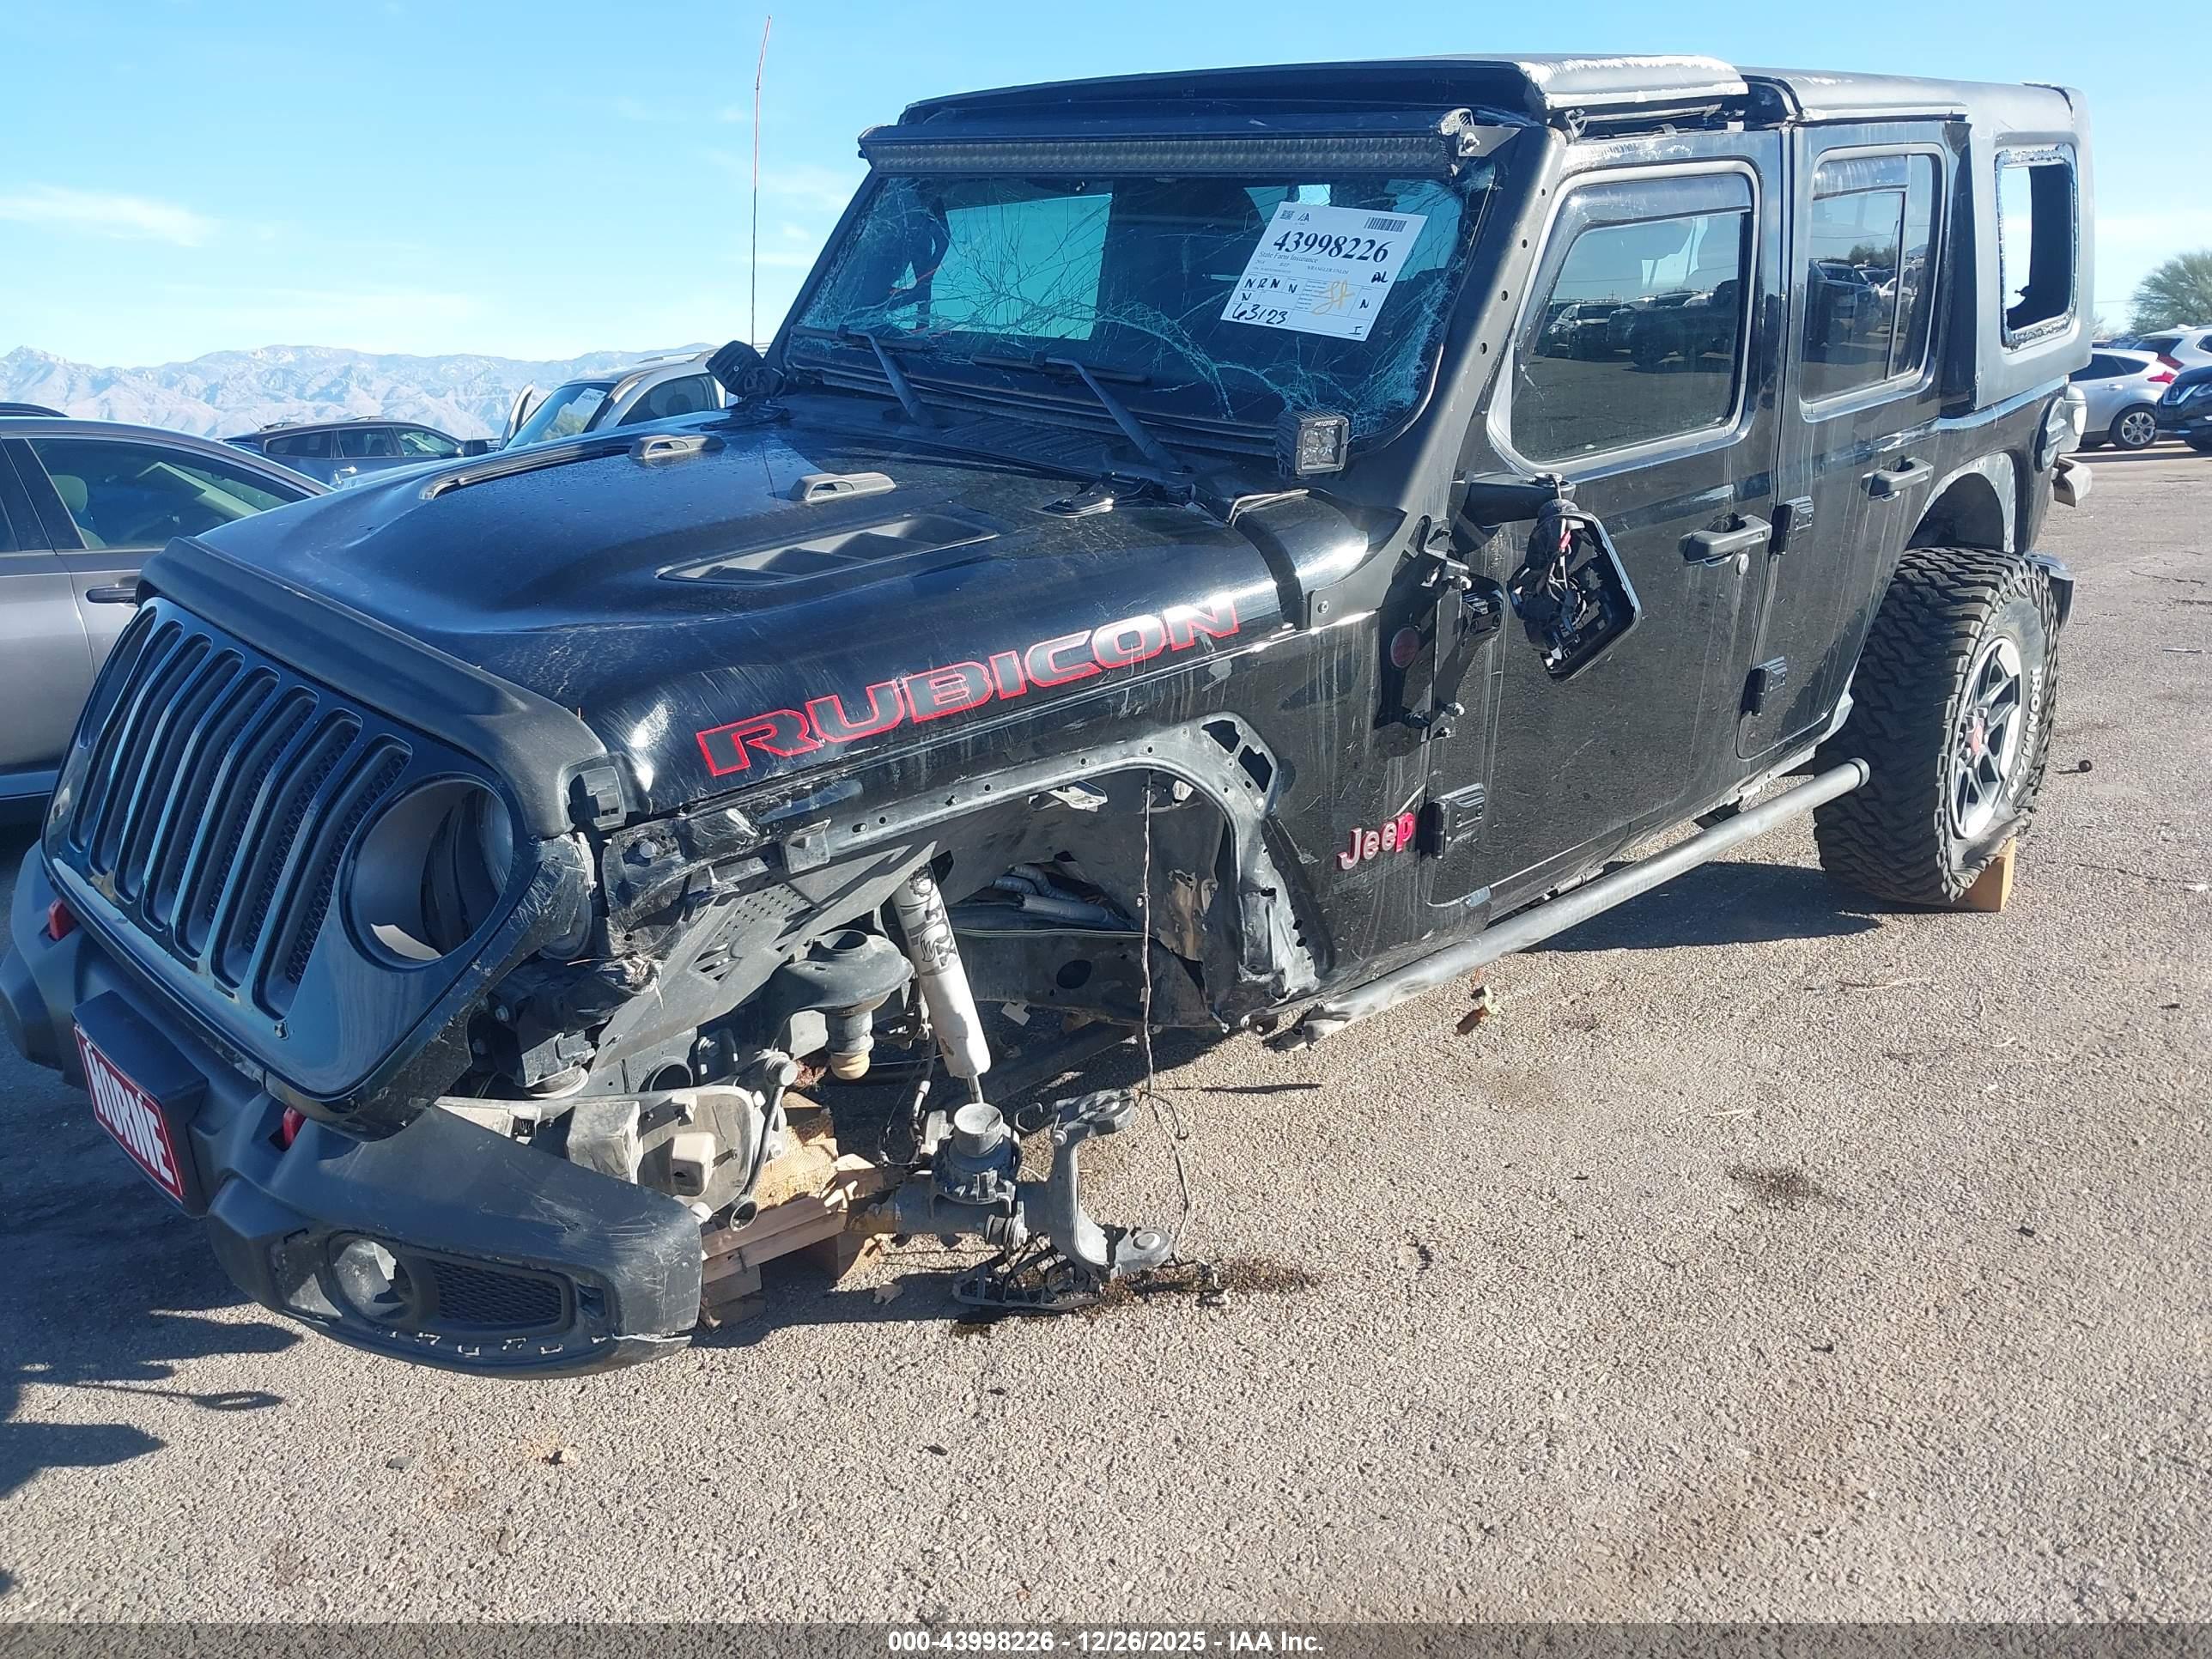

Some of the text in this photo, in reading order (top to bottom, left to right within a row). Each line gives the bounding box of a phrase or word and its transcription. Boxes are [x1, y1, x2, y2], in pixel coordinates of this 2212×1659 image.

[1273, 230, 1395, 263] 43998226
[1291, 254, 1319, 264] Insurance
[1289, 283, 1297, 293] N
[696, 599, 1242, 777] RUBICON
[2006, 665, 2043, 802] IRONMAN
[1336, 811, 1416, 871] Jeep
[83, 1043, 175, 1186] HORNE
